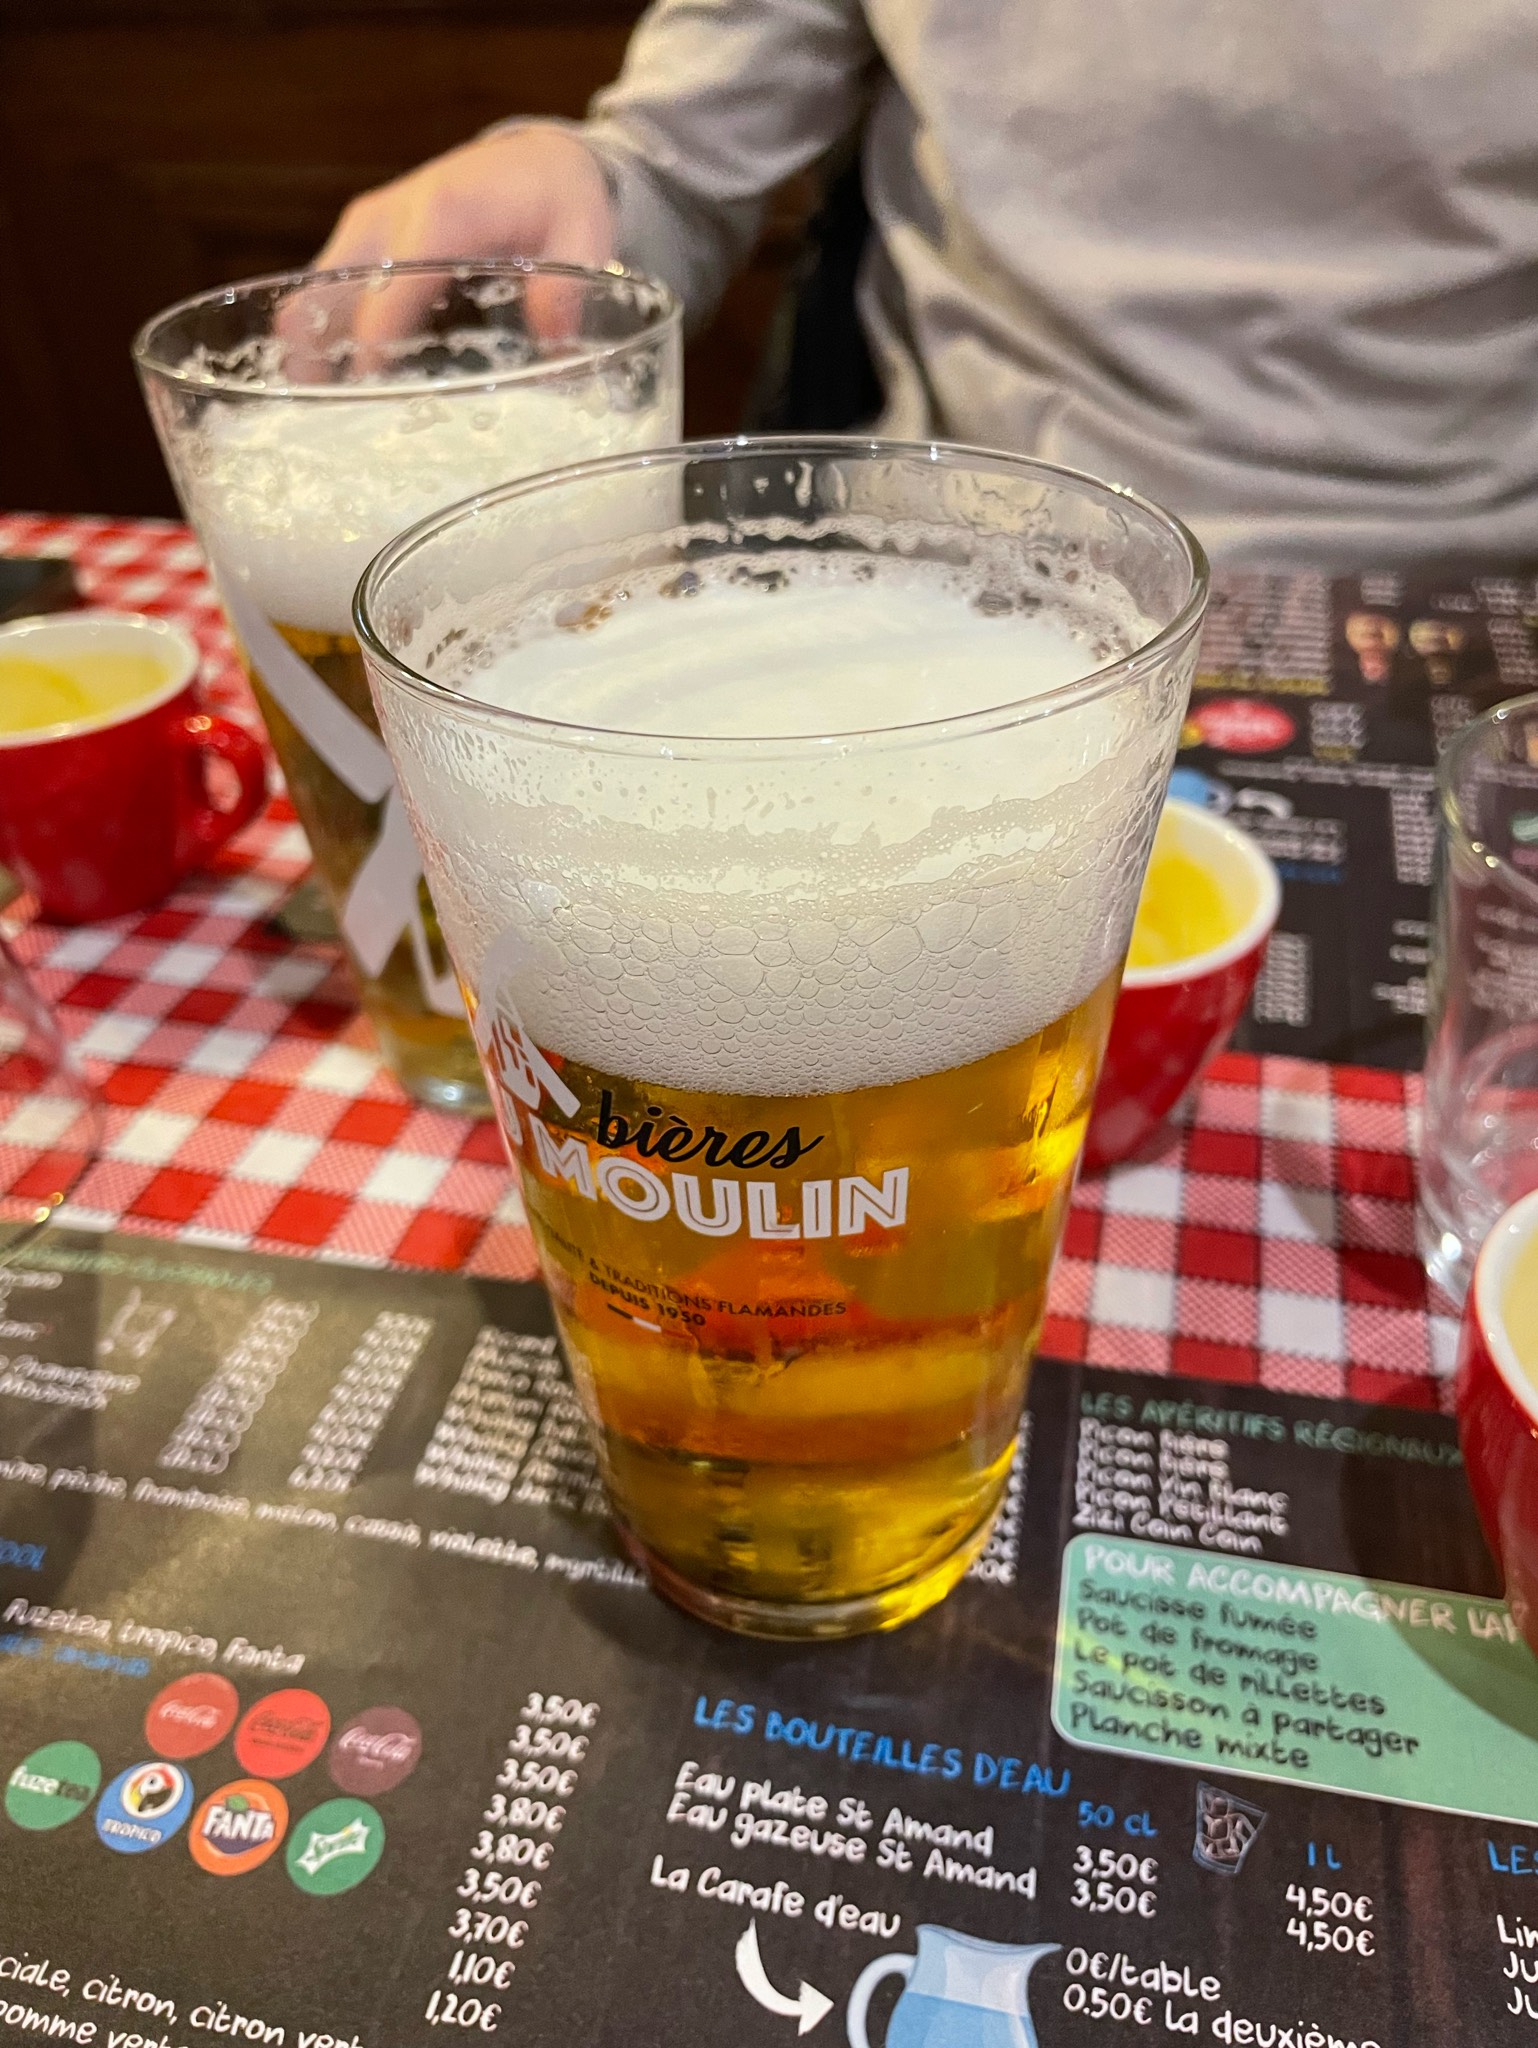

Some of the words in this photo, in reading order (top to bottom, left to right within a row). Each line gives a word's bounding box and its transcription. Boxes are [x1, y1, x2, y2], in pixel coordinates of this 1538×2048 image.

[597, 1089, 825, 1169] bières
[529, 1113, 910, 1240] MOULIN
[589, 1271, 650, 1310] DEPUIS
[658, 1302, 706, 1326] 1950
[604, 1262, 712, 1311] TRADITIONS
[718, 1300, 847, 1318] FLAMANDES
[1080, 1578, 1205, 1619] Saucisse
[1220, 1602, 1317, 1640] fumée
[1085, 1544, 1176, 1586] POUR
[1187, 1562, 1457, 1634] ACCOMPAGNER
[1078, 1607, 1126, 1636] Pot
[1141, 1621, 1178, 1645] de
[1192, 1626, 1319, 1677] fromage
[1075, 1639, 1108, 1665] Le
[1122, 1652, 1177, 1676] pot
[1190, 1661, 1227, 1686] de
[1240, 1671, 1386, 1716] rillettes
[1071, 1702, 1201, 1748] Planche
[1216, 1732, 1310, 1770] mixte
[1073, 1670, 1230, 1720] Saucisson
[1241, 1702, 1260, 1726] à
[1272, 1712, 1420, 1758] partager
[694, 1695, 755, 1735] LES
[765, 1710, 962, 1780] BOUTEILLES
[973, 1751, 1071, 1798] D'EAU
[496, 1758, 578, 1797] 3,50€
[483, 1793, 566, 1833] 3,80€
[674, 1761, 736, 1800] Eau
[740, 1780, 828, 1821] plate
[837, 1797, 874, 1832] St
[882, 1807, 995, 1859] Amand
[1078, 1800, 1115, 1829] 50
[470, 1829, 554, 1871] 3,80€
[667, 1792, 728, 1832] Eau
[731, 1812, 868, 1862] gazeuse
[876, 1837, 913, 1872] St
[923, 1848, 1037, 1900] Amand
[1073, 1845, 1159, 1885] 3,50€
[1487, 1840, 1538, 1875] LE
[456, 1868, 542, 1909] 3,50€
[650, 1853, 690, 1892] La
[698, 1865, 805, 1917] Carafe
[814, 1895, 901, 1938] d'eau
[1070, 1877, 1157, 1918] 3,50€
[1286, 1884, 1374, 1922] 4,50€
[448, 1908, 528, 1949] 3,70€
[1286, 1917, 1375, 1957] 4,50€
[448, 1950, 515, 1989] 1,10€
[1065, 1947, 1221, 2000] 0€/table
[82, 1974, 178, 2026] citron,
[190, 2001, 285, 2046] citron
[425, 1990, 501, 2032] 1,20€
[1062, 1983, 1153, 2025] 0.50€
[1165, 2000, 1199, 2035] la
